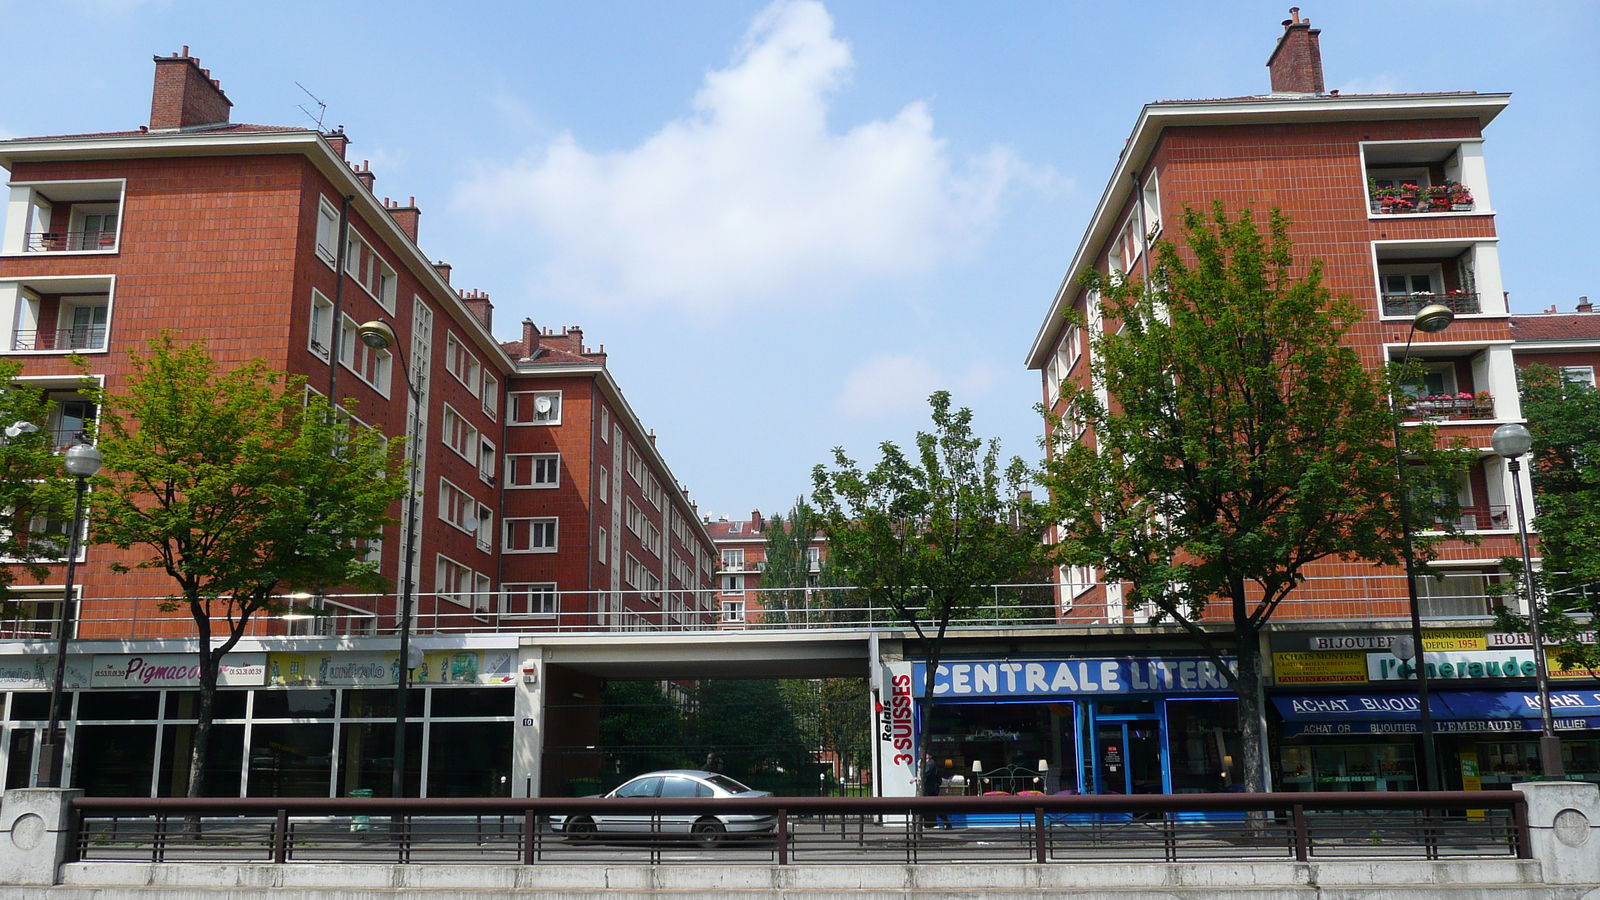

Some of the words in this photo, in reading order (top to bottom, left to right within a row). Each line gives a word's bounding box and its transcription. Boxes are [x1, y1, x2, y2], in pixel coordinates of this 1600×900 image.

[1425, 641, 1454, 649] DEPUIS
[1458, 640, 1478, 648] 1954
[1278, 653, 1315, 661] ACHATS
[1317, 652, 1361, 660] MONTRES
[329, 662, 385, 679] unikalo
[924, 662, 1120, 694] CENTRALE
[891, 674, 913, 750] SUISSES
[1292, 699, 1351, 712] ACHAT
[881, 700, 892, 741] Relais
[1303, 724, 1333, 733] ACHAT
[1337, 724, 1351, 732] OR
[1370, 723, 1417, 732] BIJOUTIER
[1436, 720, 1522, 732] L'EMERAUDE
[893, 753, 914, 766] 3
